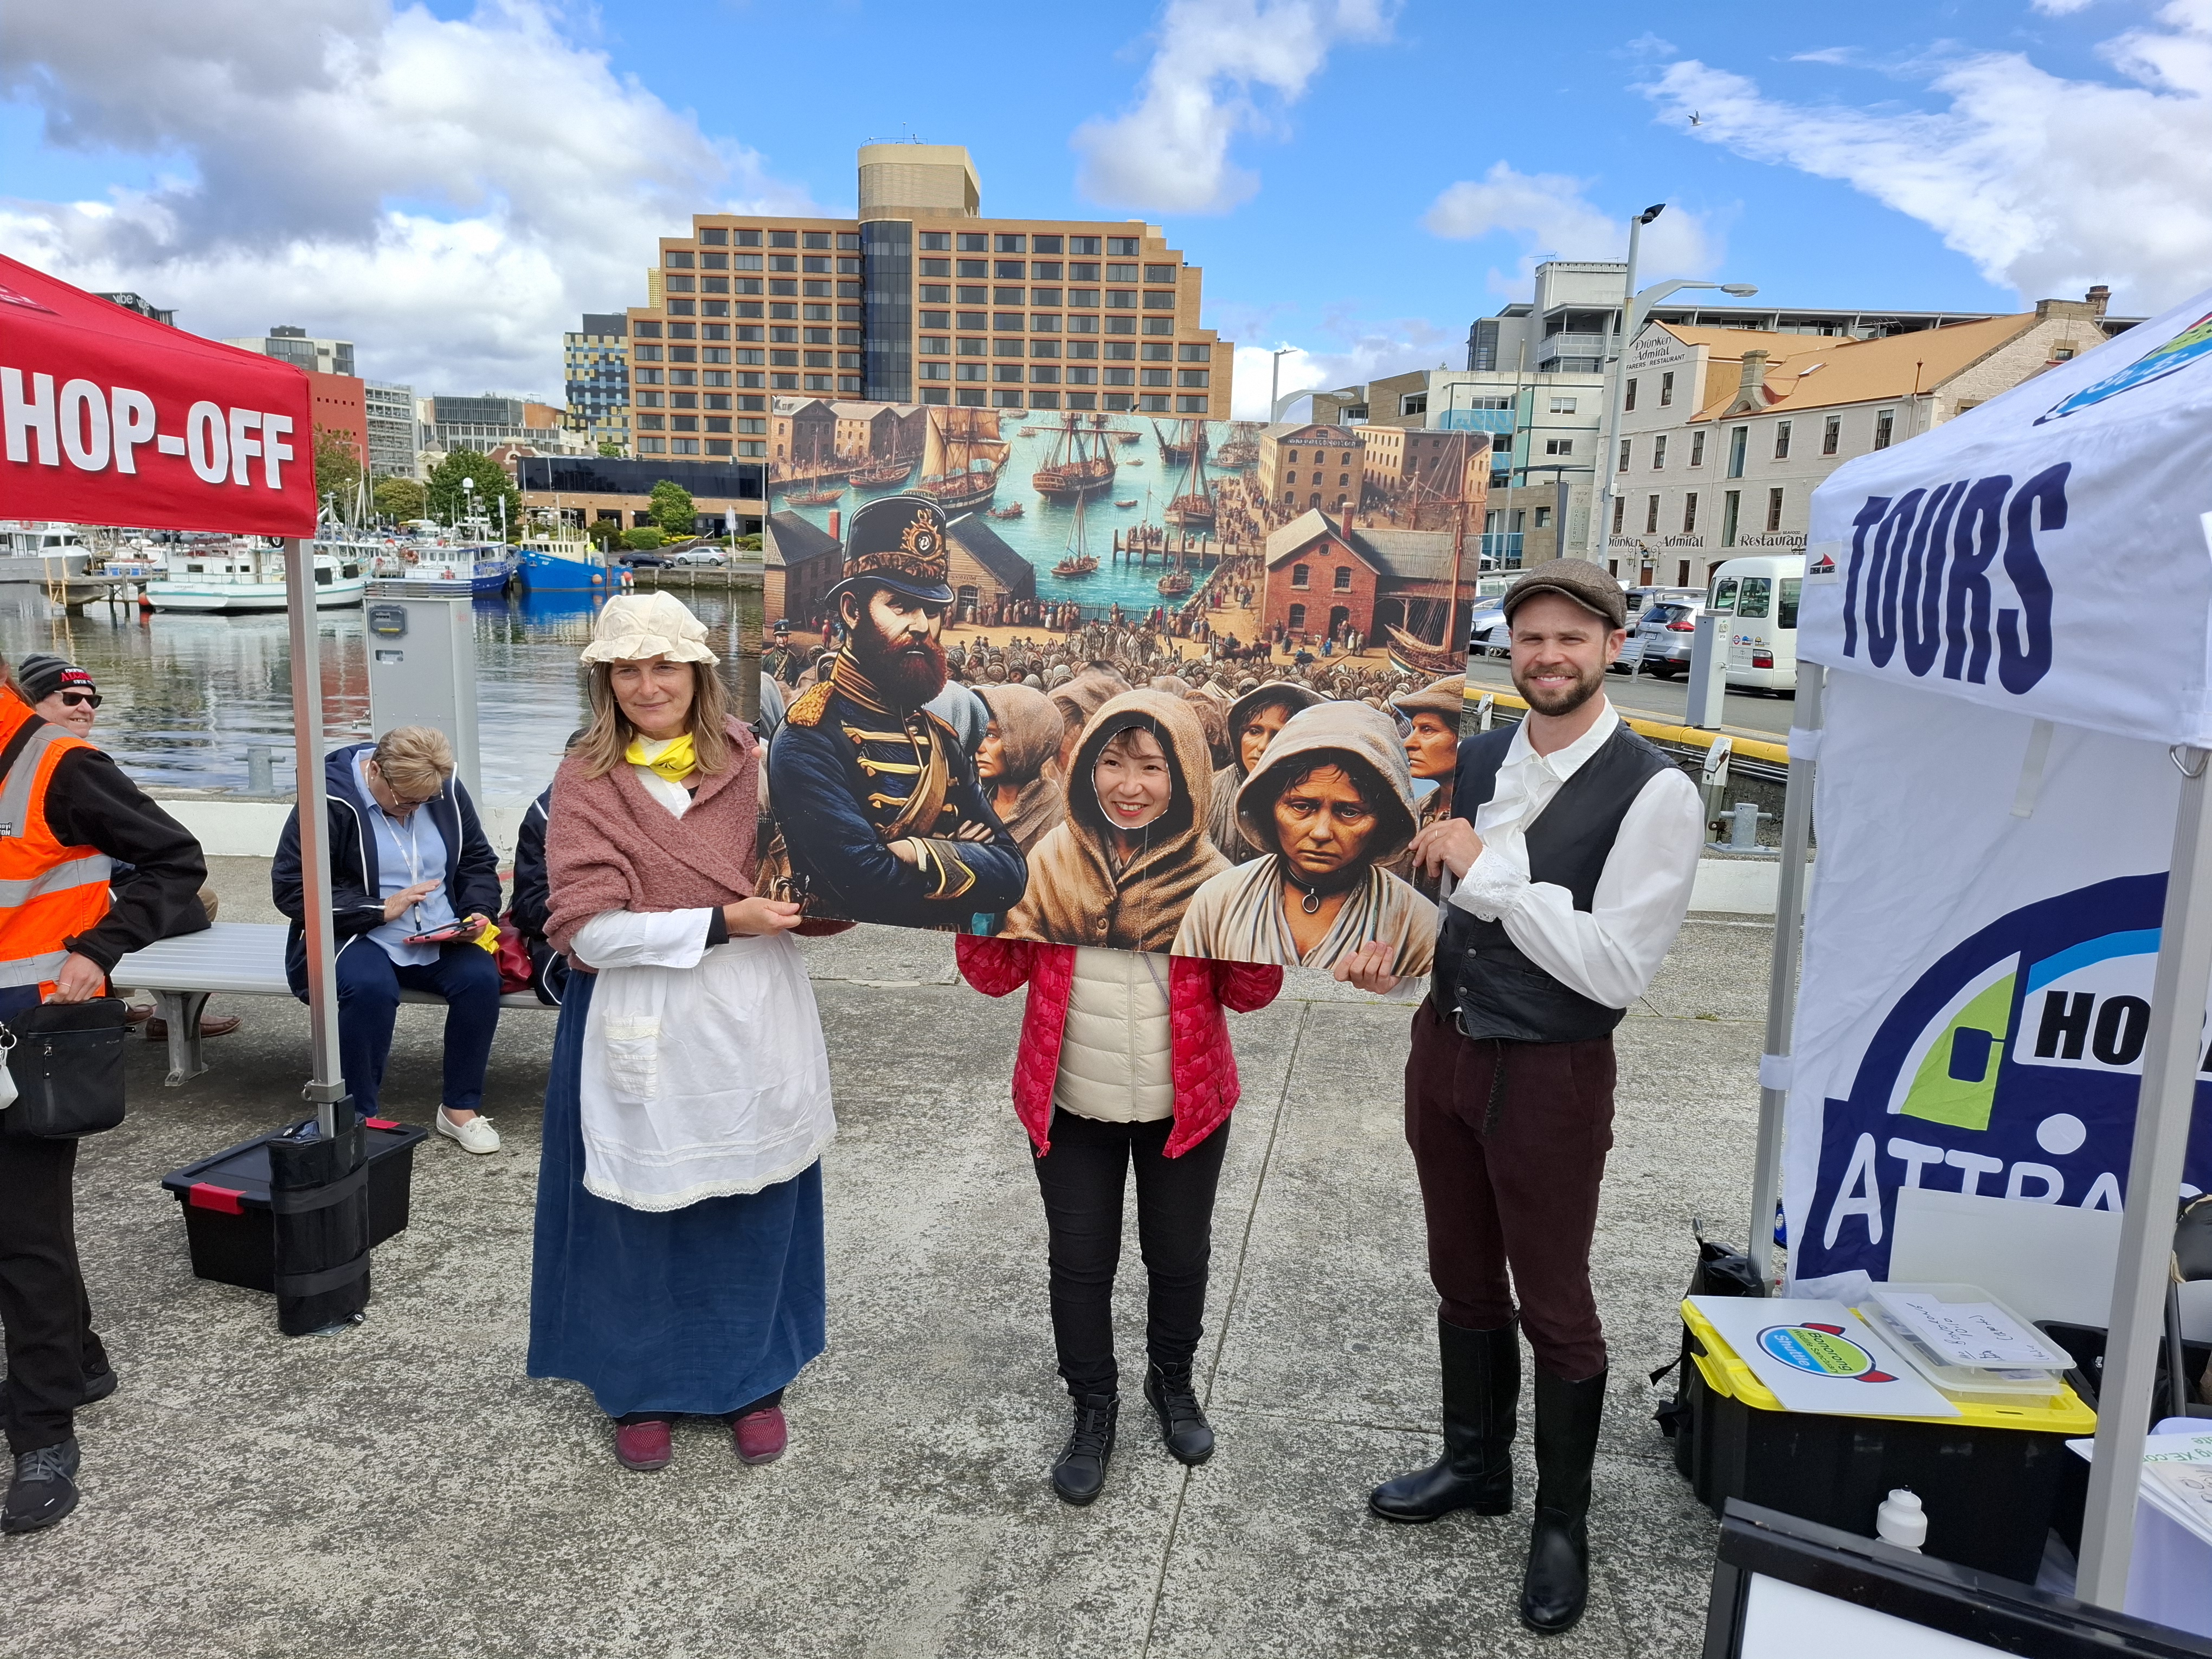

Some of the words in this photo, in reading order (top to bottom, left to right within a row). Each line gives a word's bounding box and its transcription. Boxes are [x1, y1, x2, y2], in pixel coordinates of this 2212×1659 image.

[112, 292, 133, 304] vibe
[136, 297, 150, 310] vibe
[1632, 346, 1670, 362] Admiral
[1634, 336, 1671, 351] Drunken
[1650, 354, 1685, 366] RESTAURANT
[1, 366, 293, 489] HOP-OFF
[1656, 535, 1703, 548] Admiral
[1739, 533, 1808, 548] Restaurant
[1843, 461, 2072, 695] TOURS
[2034, 991, 2212, 1072] HO
[1774, 1334, 1810, 1366] Shuttle
[1791, 1329, 1813, 1347] Wildlife
[1810, 1347, 1840, 1374] Sanctuary
[1808, 1332, 1854, 1371] Bonorong
